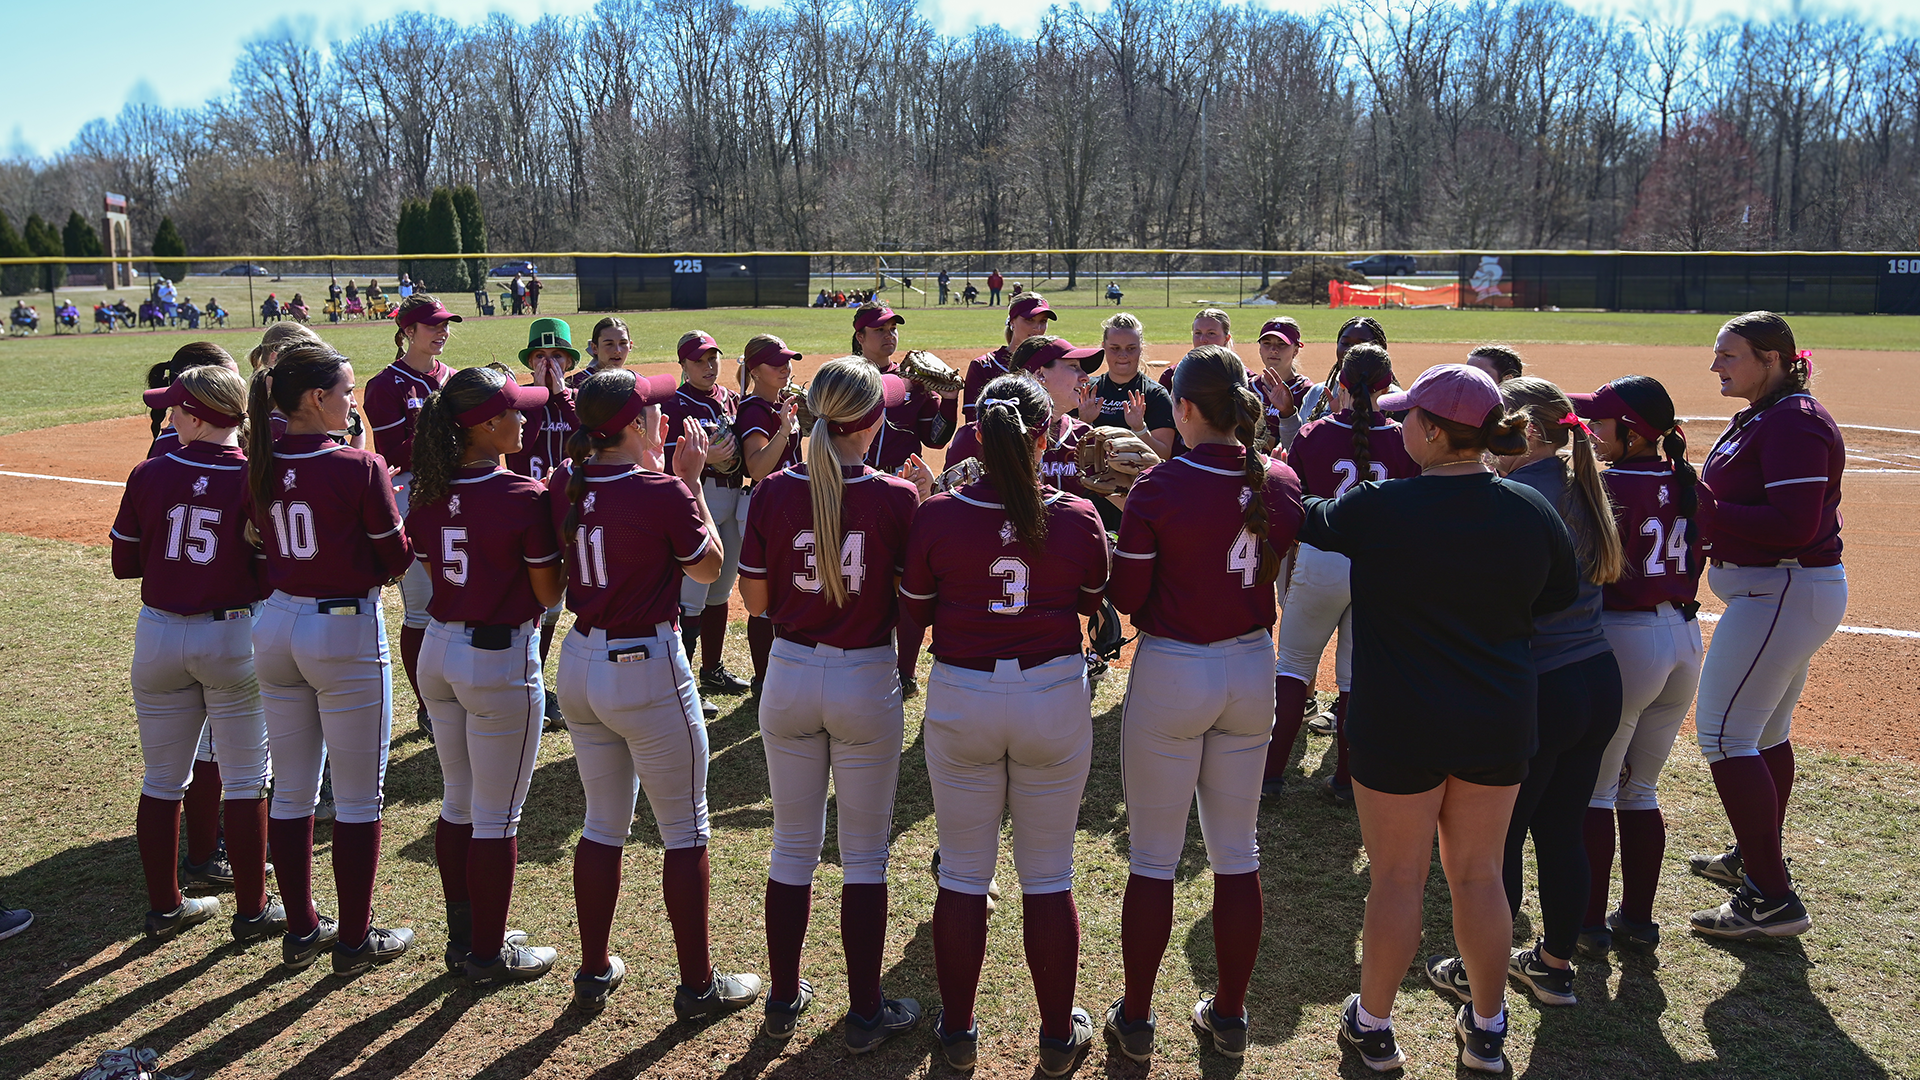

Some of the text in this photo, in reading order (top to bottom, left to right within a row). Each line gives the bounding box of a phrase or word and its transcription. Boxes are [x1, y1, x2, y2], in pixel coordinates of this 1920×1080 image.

[673, 259, 702, 273] 225
[1888, 259, 1920, 274] 190
[164, 503, 222, 566] 15
[268, 500, 319, 560] 10
[441, 526, 469, 587] 5
[573, 524, 608, 589] 11
[1226, 522, 1261, 589] 4
[1639, 516, 1688, 577] 24
[792, 529, 866, 595] 34
[987, 556, 1030, 616] 3
